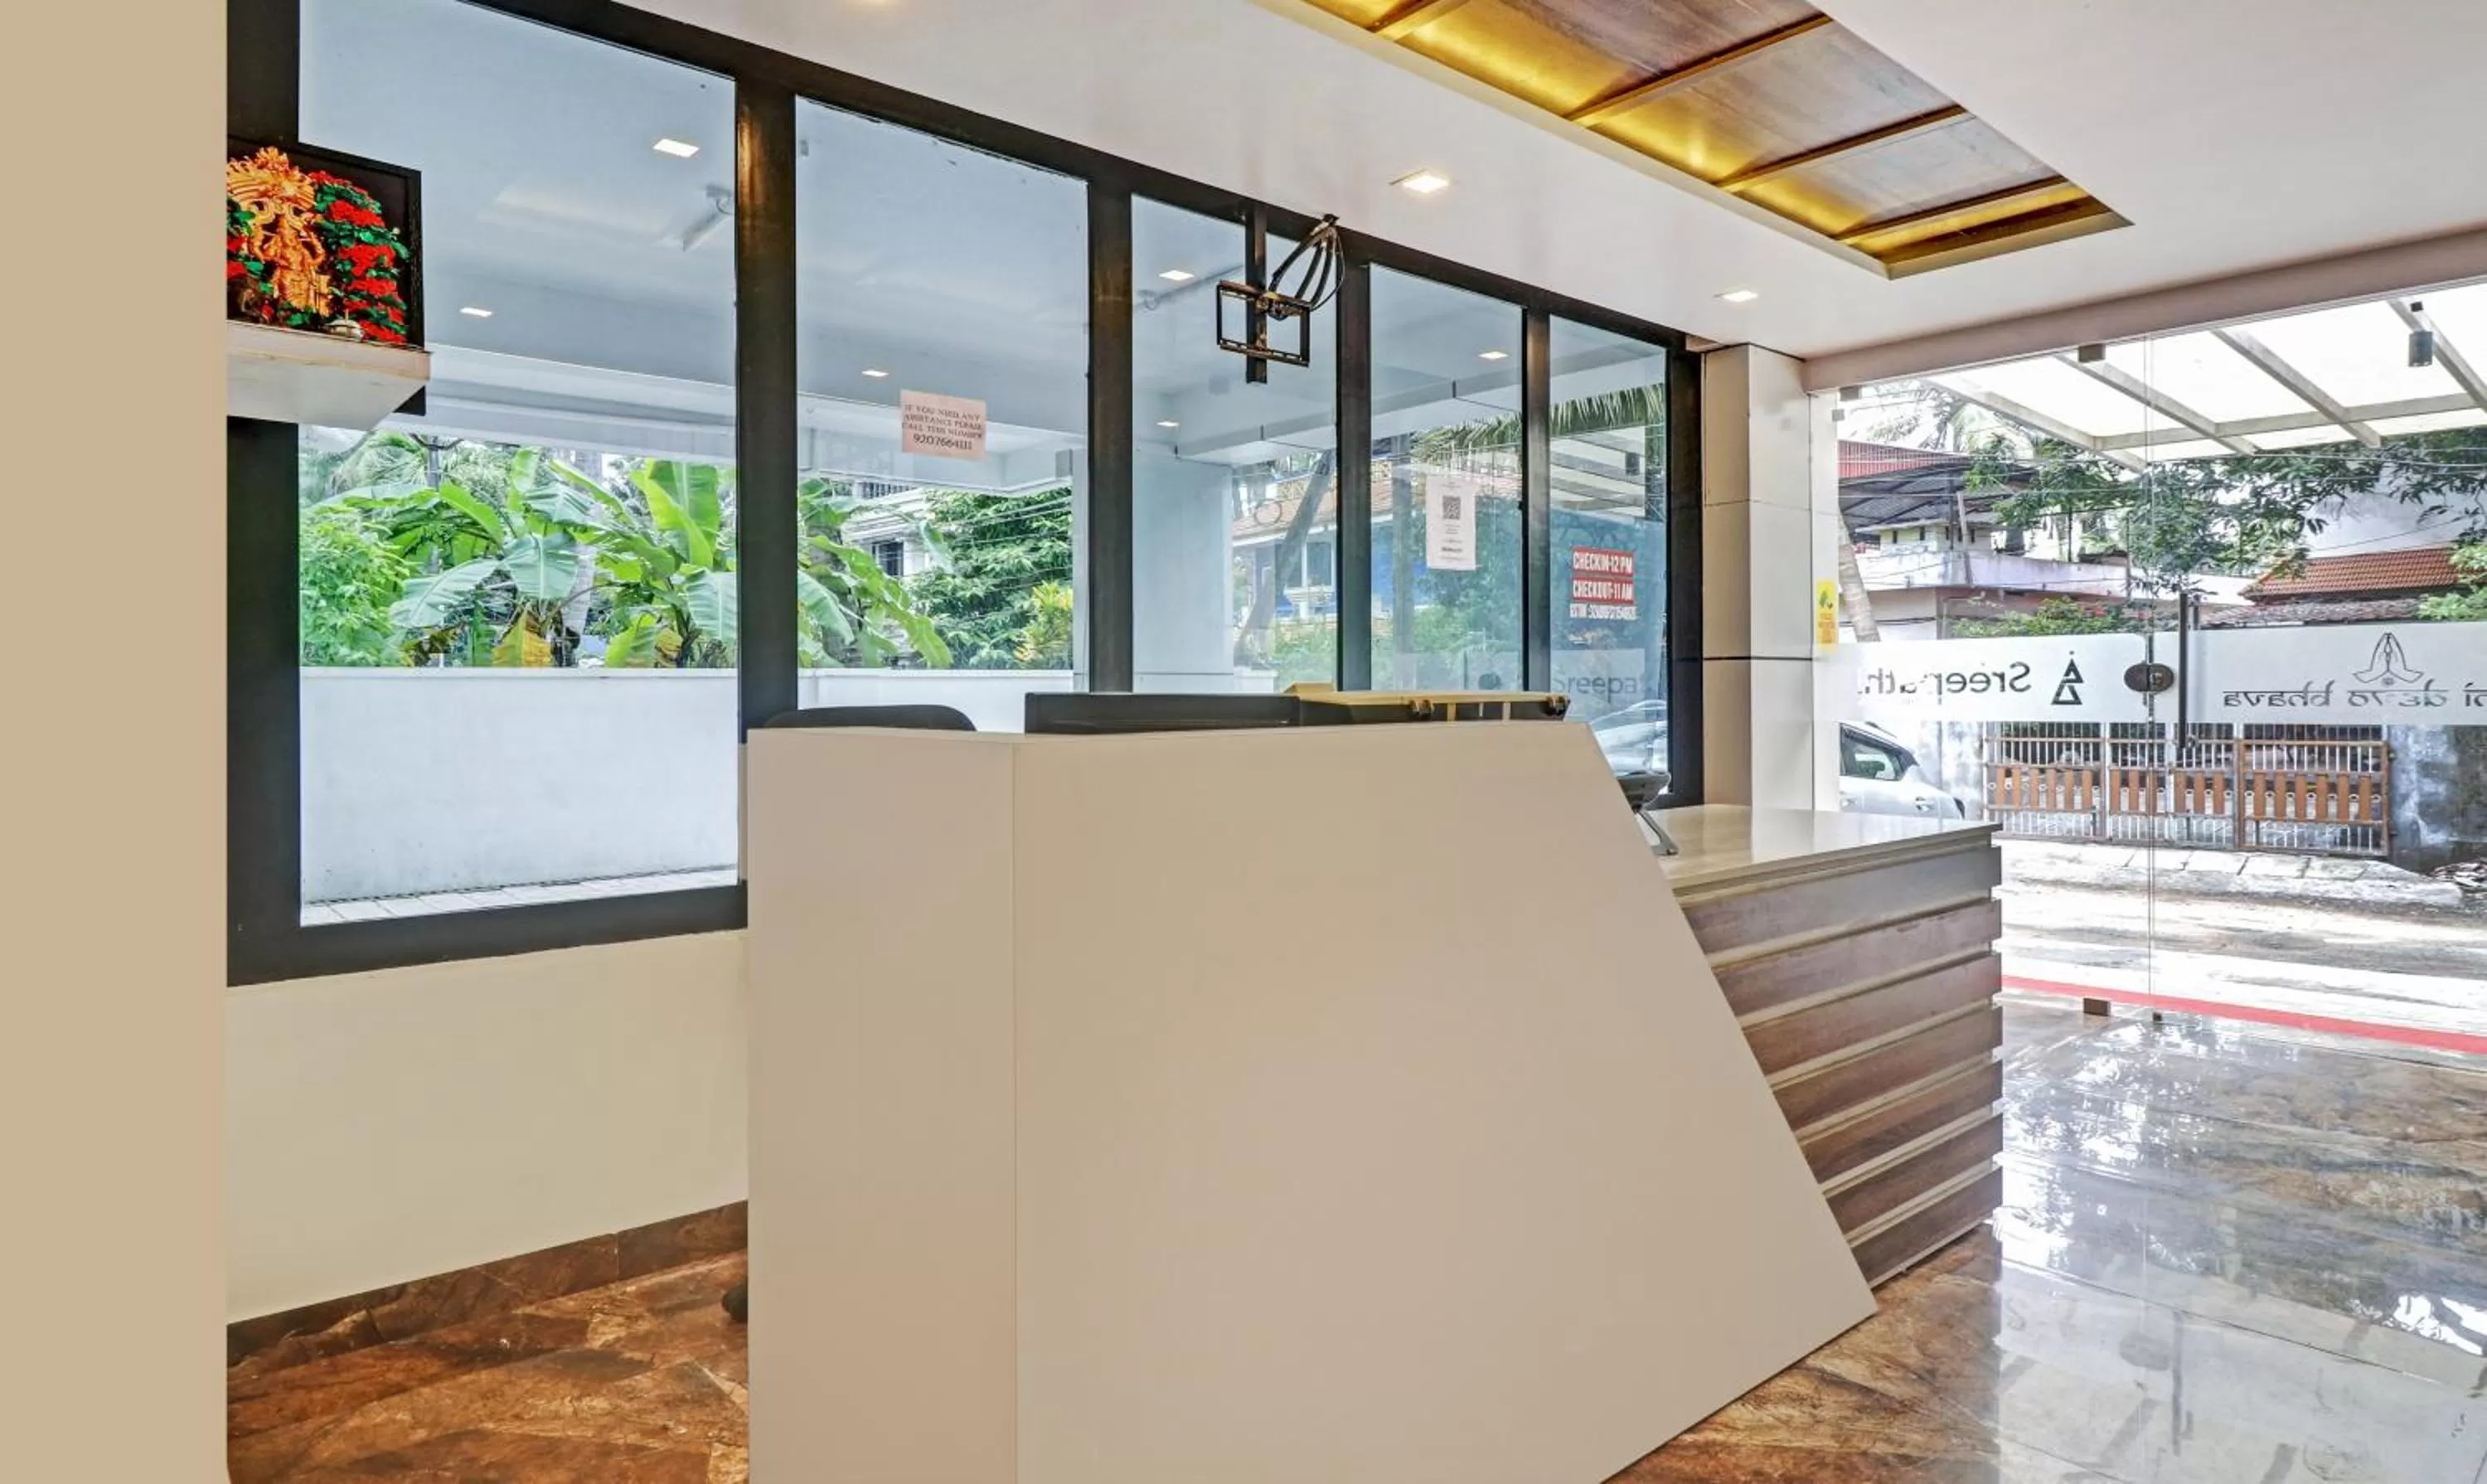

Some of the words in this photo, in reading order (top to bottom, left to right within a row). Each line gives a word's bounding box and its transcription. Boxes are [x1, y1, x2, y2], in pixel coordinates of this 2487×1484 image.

[916, 405, 936, 415] YOU
[938, 409, 959, 418] NEED
[962, 413, 981, 421] ANY
[1621, 555, 1632, 574] PM
[1622, 582, 1633, 601] AM
